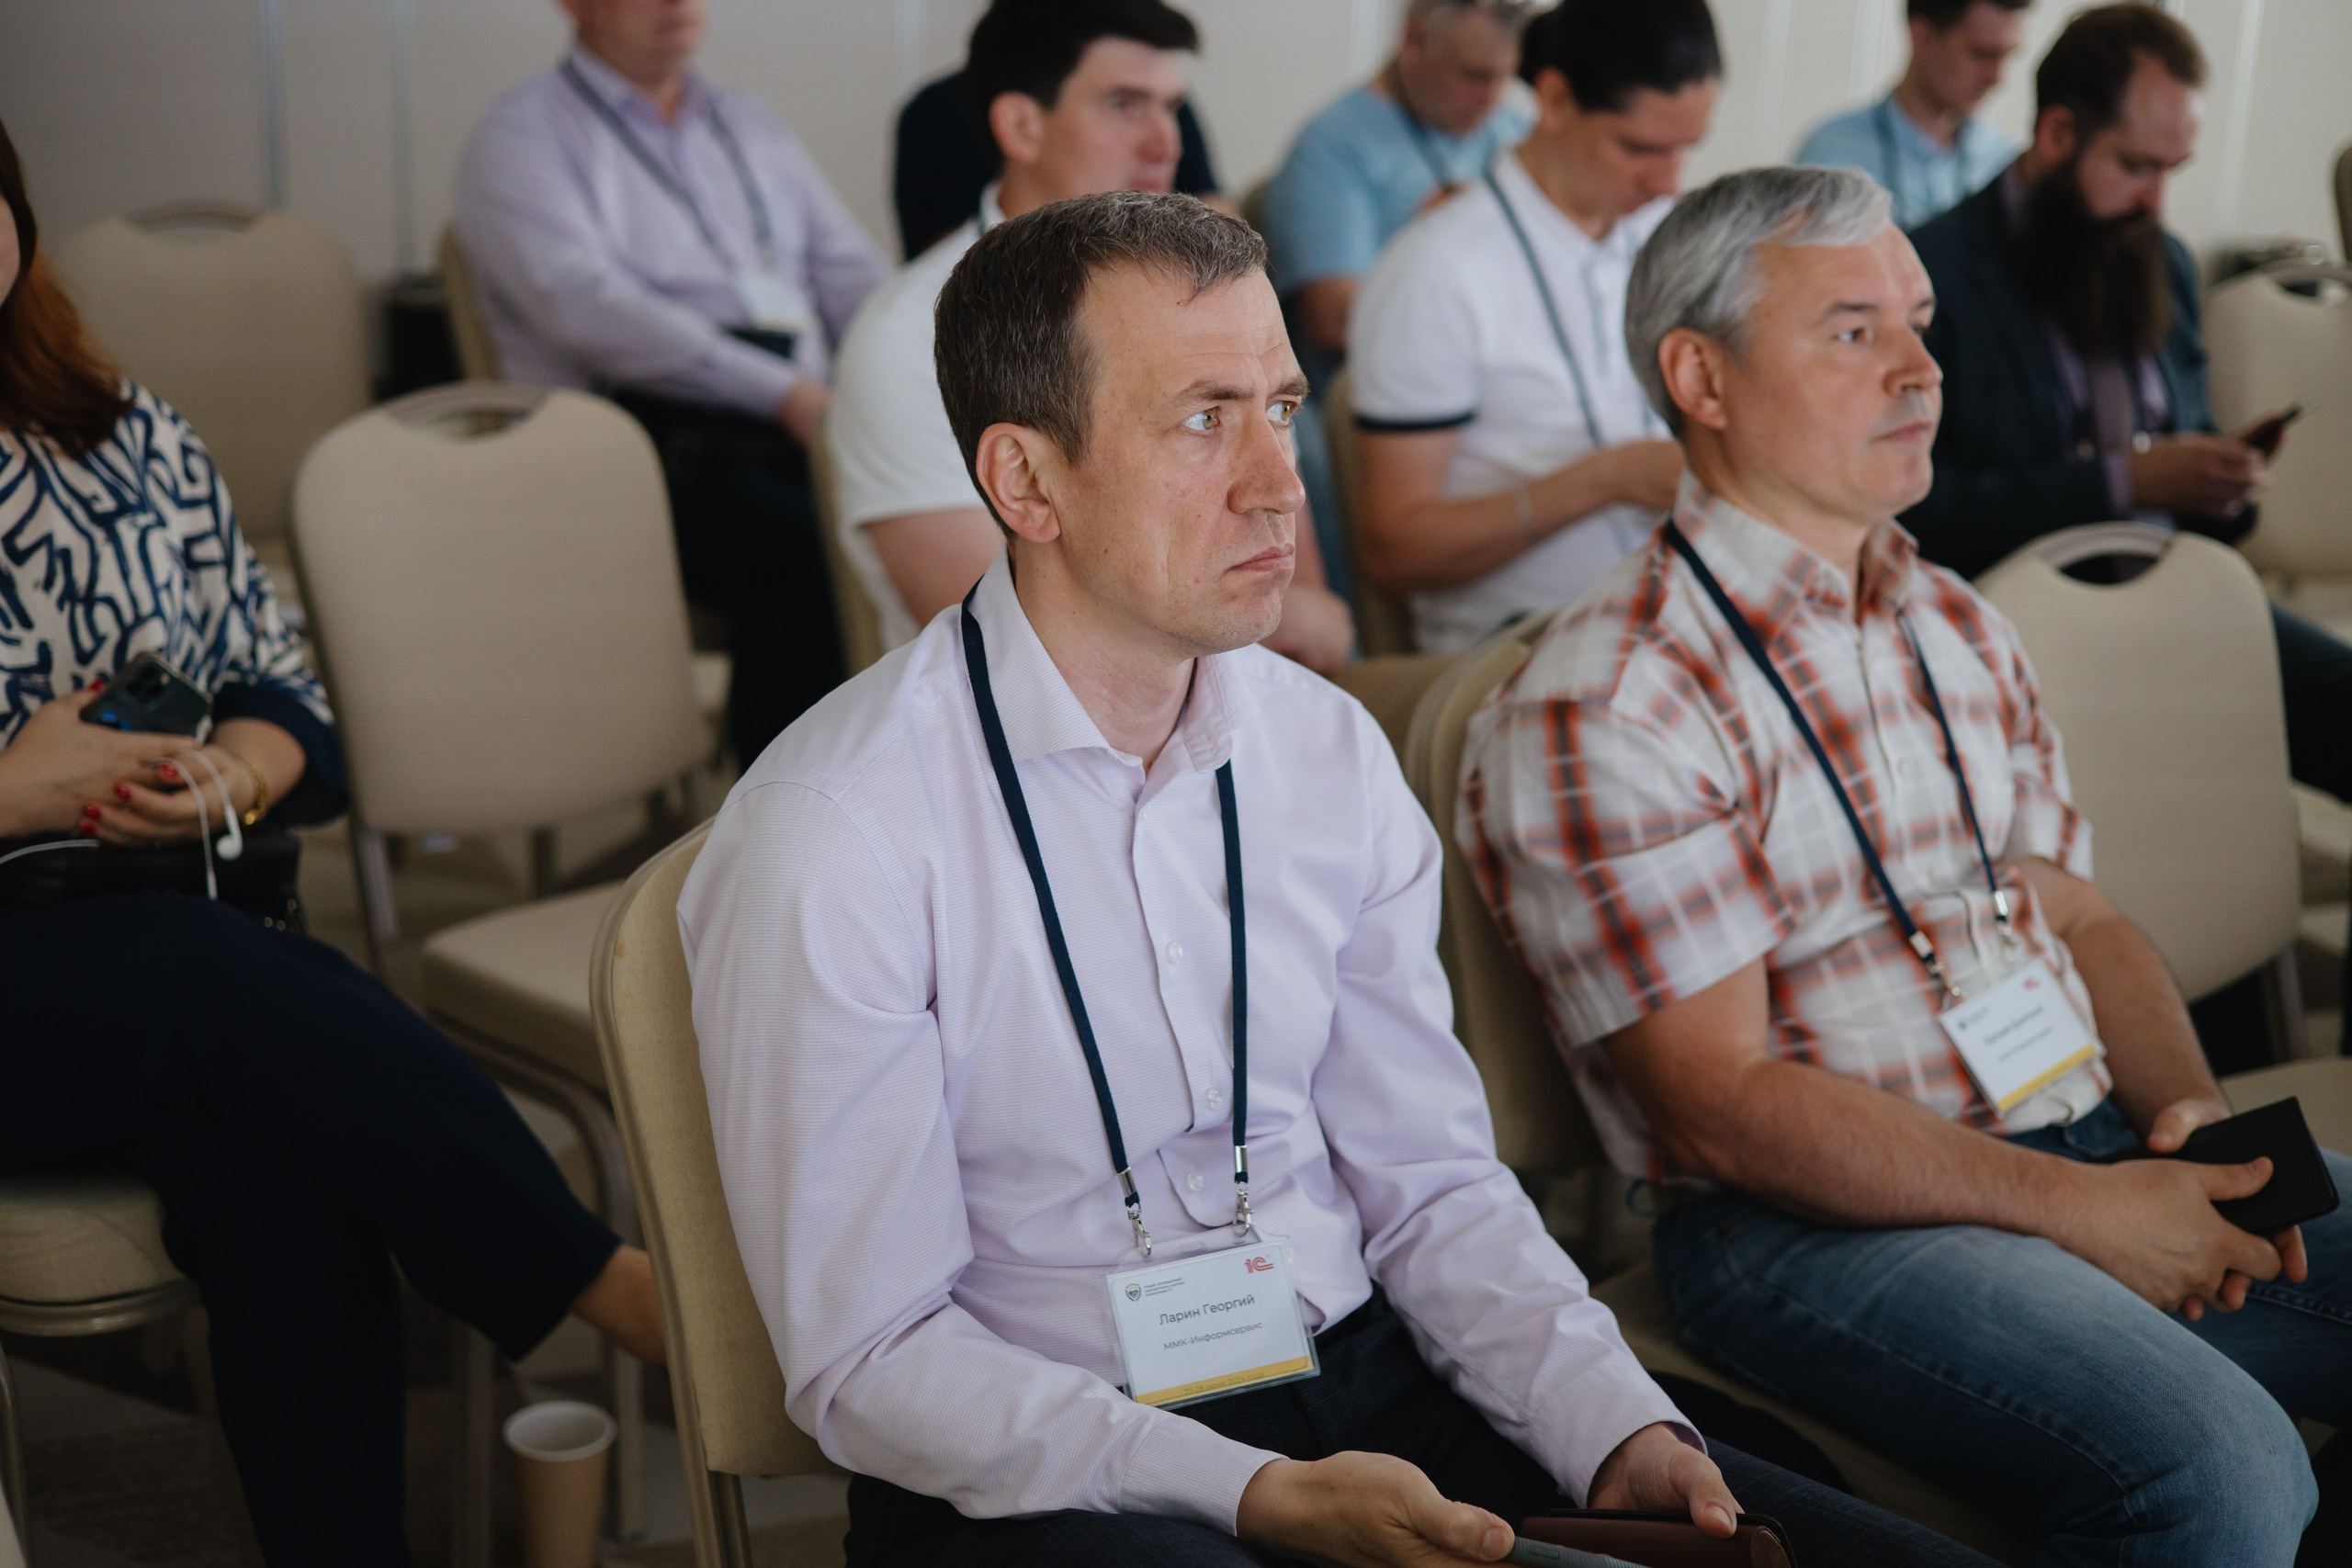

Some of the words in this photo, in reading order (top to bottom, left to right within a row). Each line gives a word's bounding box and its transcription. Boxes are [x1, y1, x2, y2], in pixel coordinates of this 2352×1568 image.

[1159, 1308, 1201, 1325] Ларин
[1203, 1294, 1255, 1314] Георгий
[1163, 1322, 1263, 1350] ММК-Информсервис
